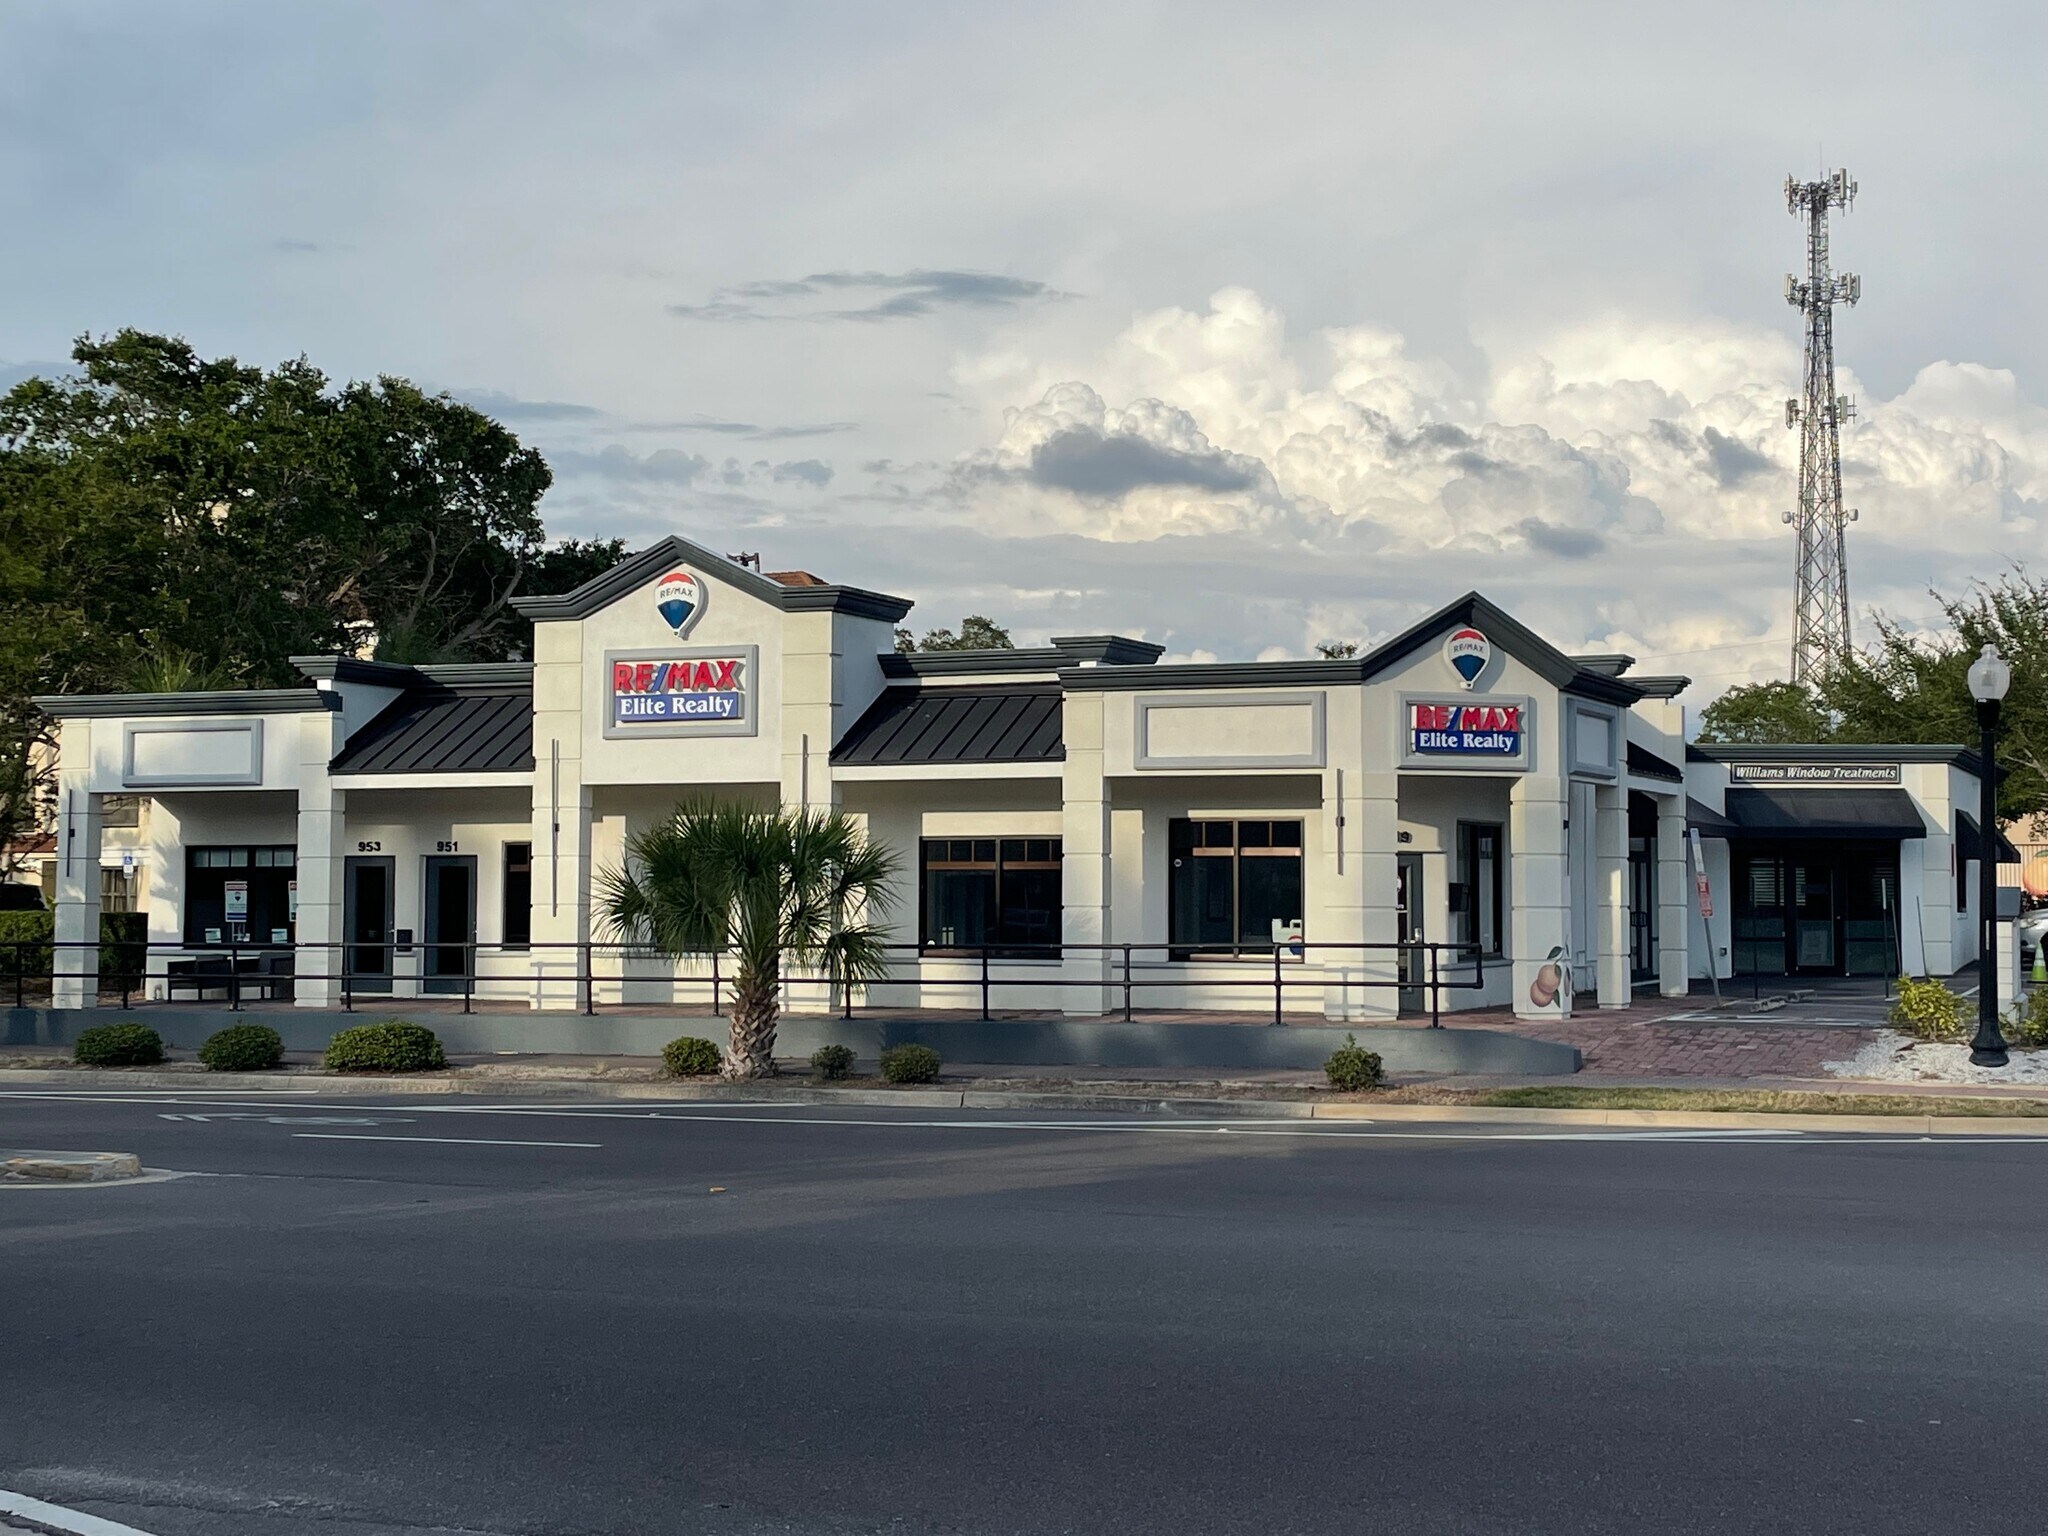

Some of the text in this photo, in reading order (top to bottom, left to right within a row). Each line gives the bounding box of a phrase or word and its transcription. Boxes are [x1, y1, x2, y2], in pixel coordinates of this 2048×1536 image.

[660, 587, 693, 598] RE/MAX
[1453, 643, 1484, 653] RE/MAX
[614, 660, 737, 692] RE/MAX
[620, 696, 734, 717] Elite Realty
[1416, 705, 1519, 732] RE/MAX
[1419, 732, 1514, 752] Elite Realty
[1736, 766, 1896, 779] Williams Window Treatments
[358, 841, 381, 852] 953
[436, 841, 458, 852] 951
